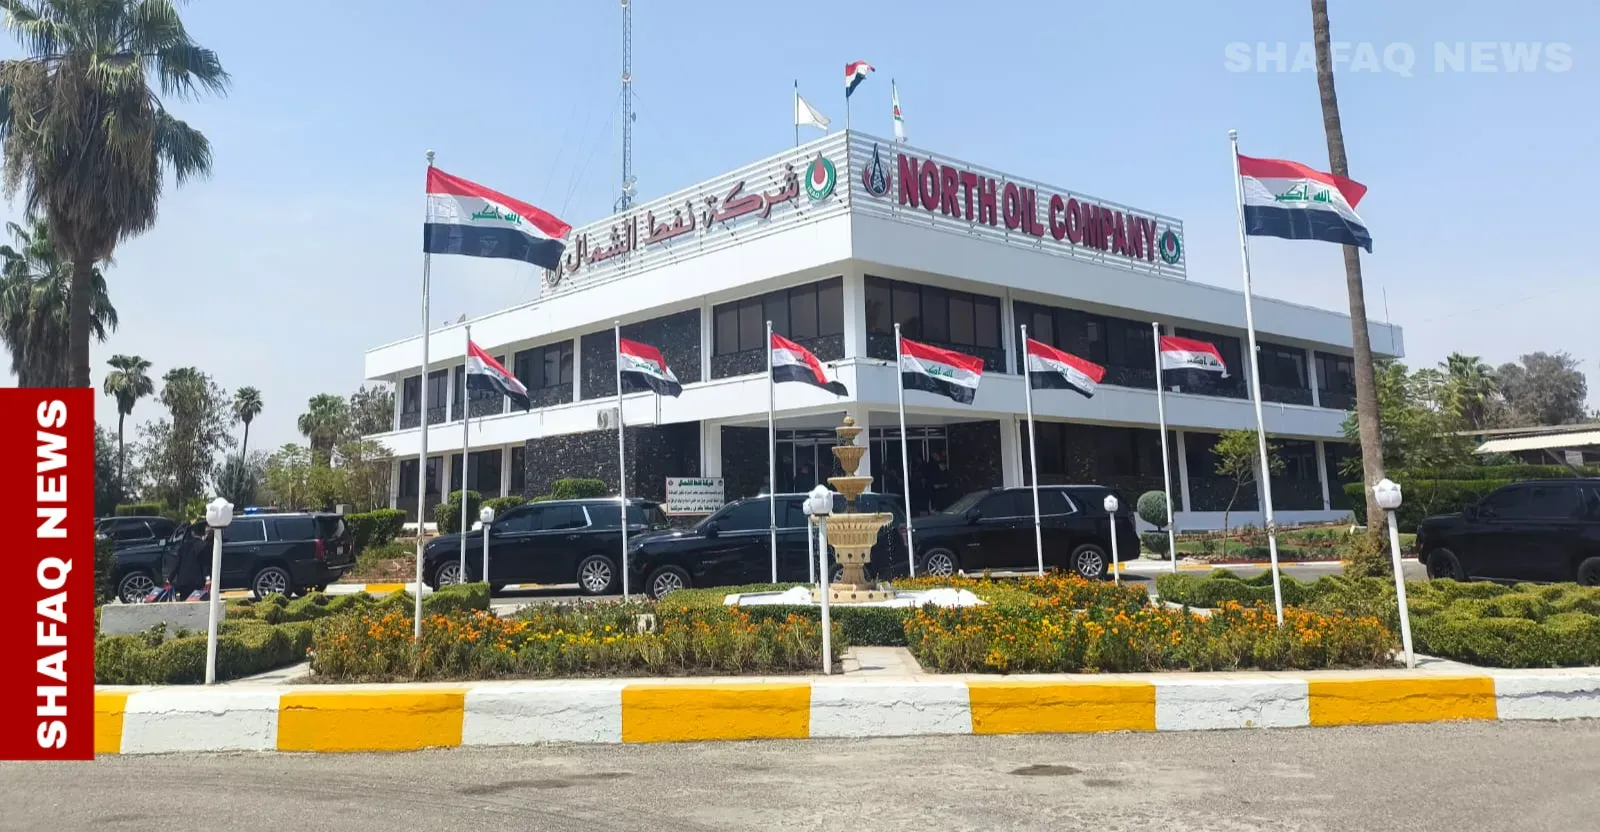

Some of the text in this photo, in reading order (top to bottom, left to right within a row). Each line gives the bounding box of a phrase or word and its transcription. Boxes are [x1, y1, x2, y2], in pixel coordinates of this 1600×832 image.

[565, 162, 800, 272] شركة نفط الشمال
[897, 153, 1157, 262] NORTH OIL COMPANY
